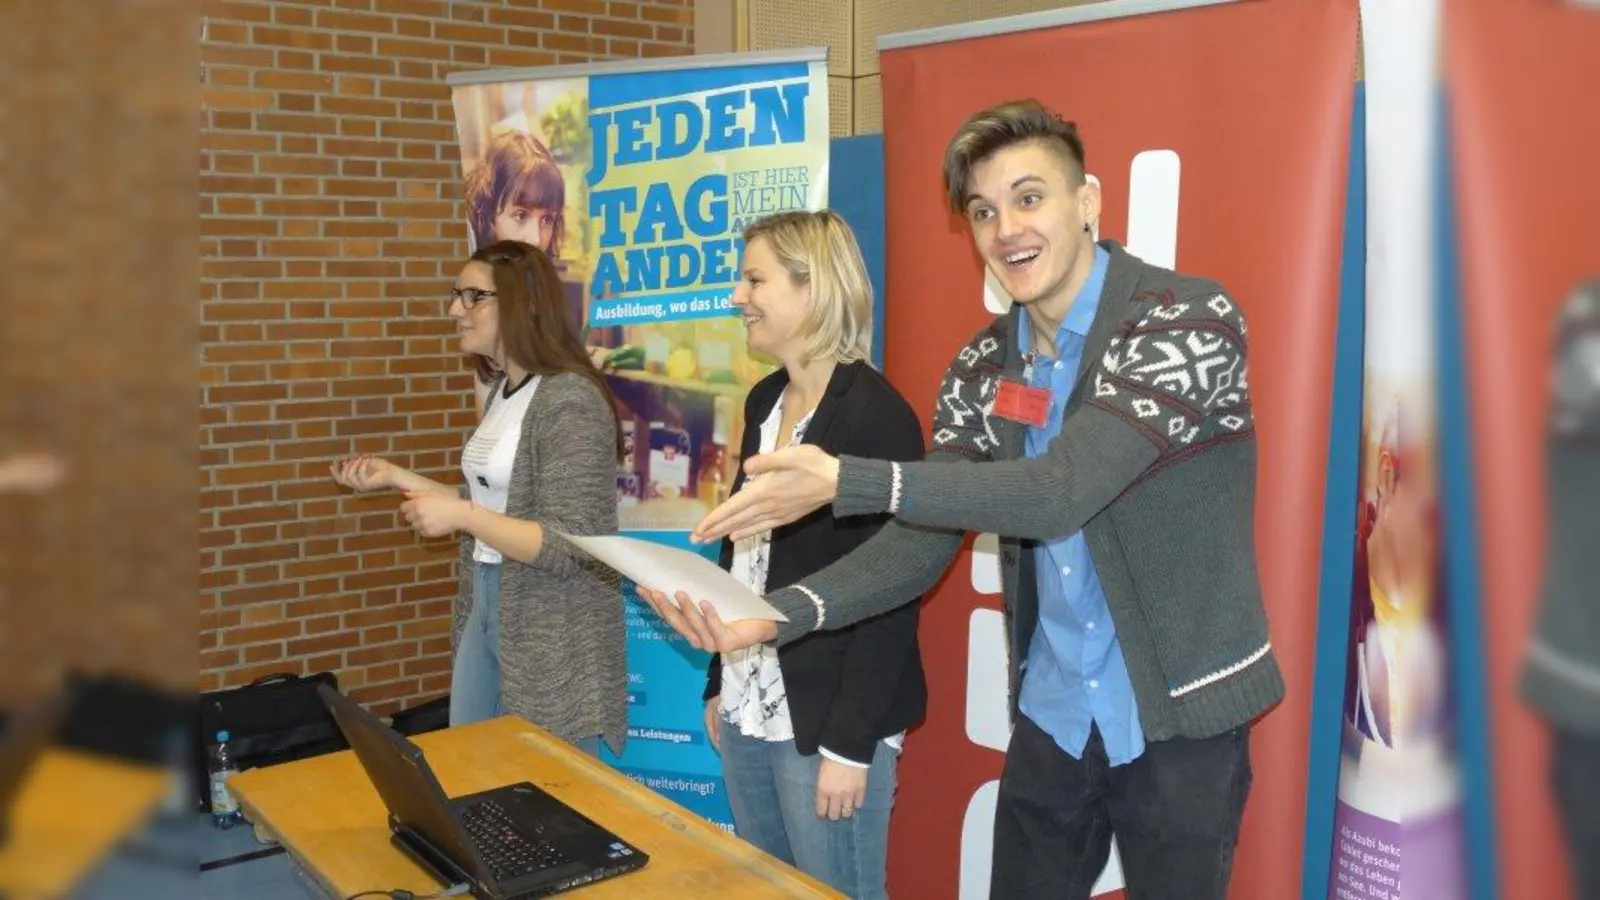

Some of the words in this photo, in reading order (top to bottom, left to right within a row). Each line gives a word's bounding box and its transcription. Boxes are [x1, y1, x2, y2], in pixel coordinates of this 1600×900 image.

[586, 82, 810, 187] JEDEN
[733, 170, 760, 189] IST
[765, 166, 809, 186] HIER
[589, 174, 729, 248] TAG
[732, 184, 809, 216] MEIN
[595, 300, 667, 320] Ausbildung,
[670, 302, 688, 314] wo
[690, 297, 711, 312] das
[640, 728, 692, 744] Leistungen
[646, 776, 716, 796] weiterbringt?
[1366, 868, 1394, 886] Leben
[1370, 884, 1388, 900] Und
